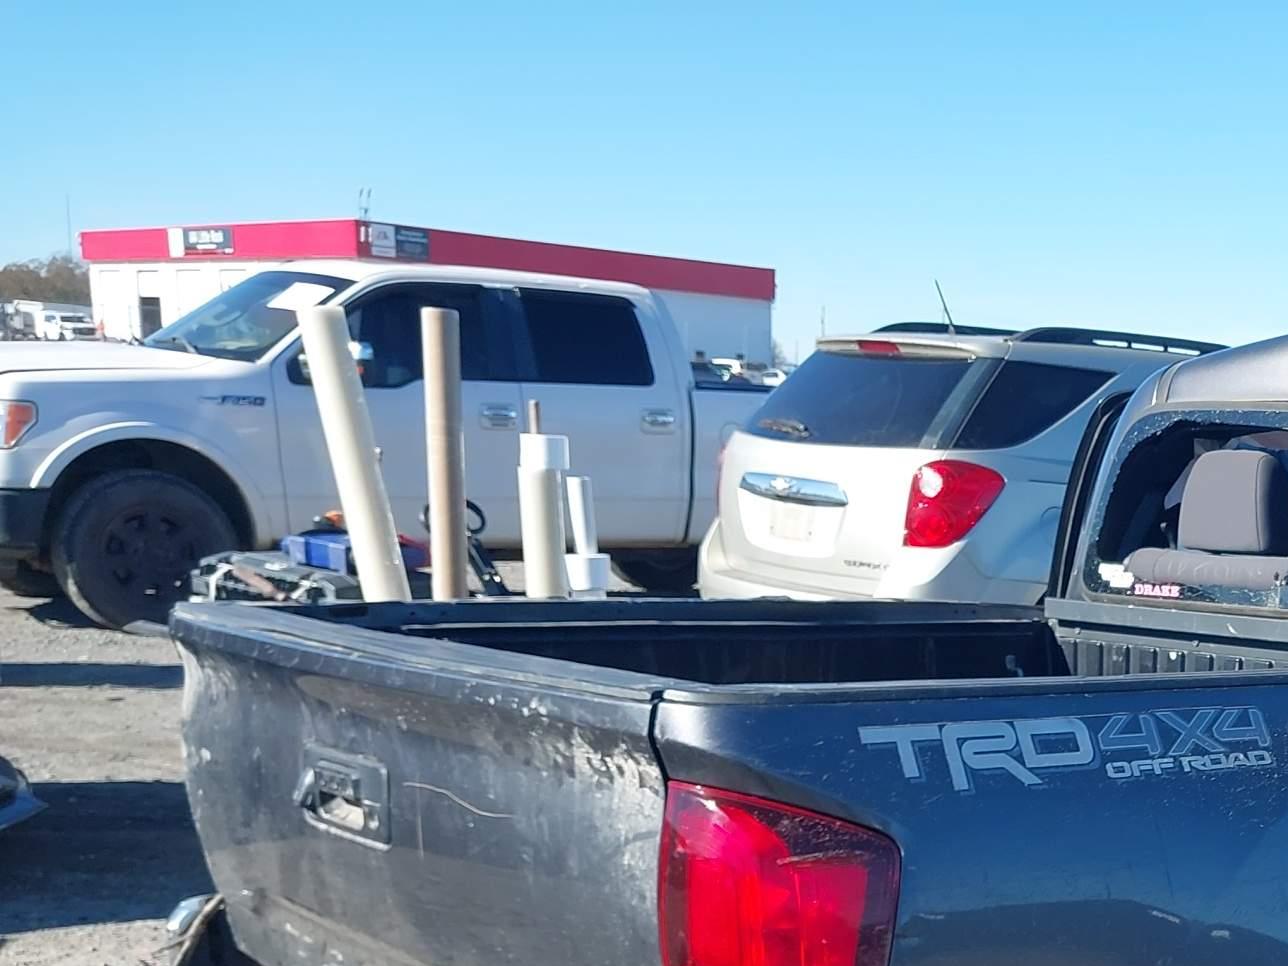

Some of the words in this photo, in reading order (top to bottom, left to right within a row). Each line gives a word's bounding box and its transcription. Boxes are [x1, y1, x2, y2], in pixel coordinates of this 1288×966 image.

[1134, 583, 1181, 598] DRAKE
[857, 716, 1093, 792] TRD
[1105, 758, 1174, 779] OFF
[1179, 749, 1272, 772] ROAD
